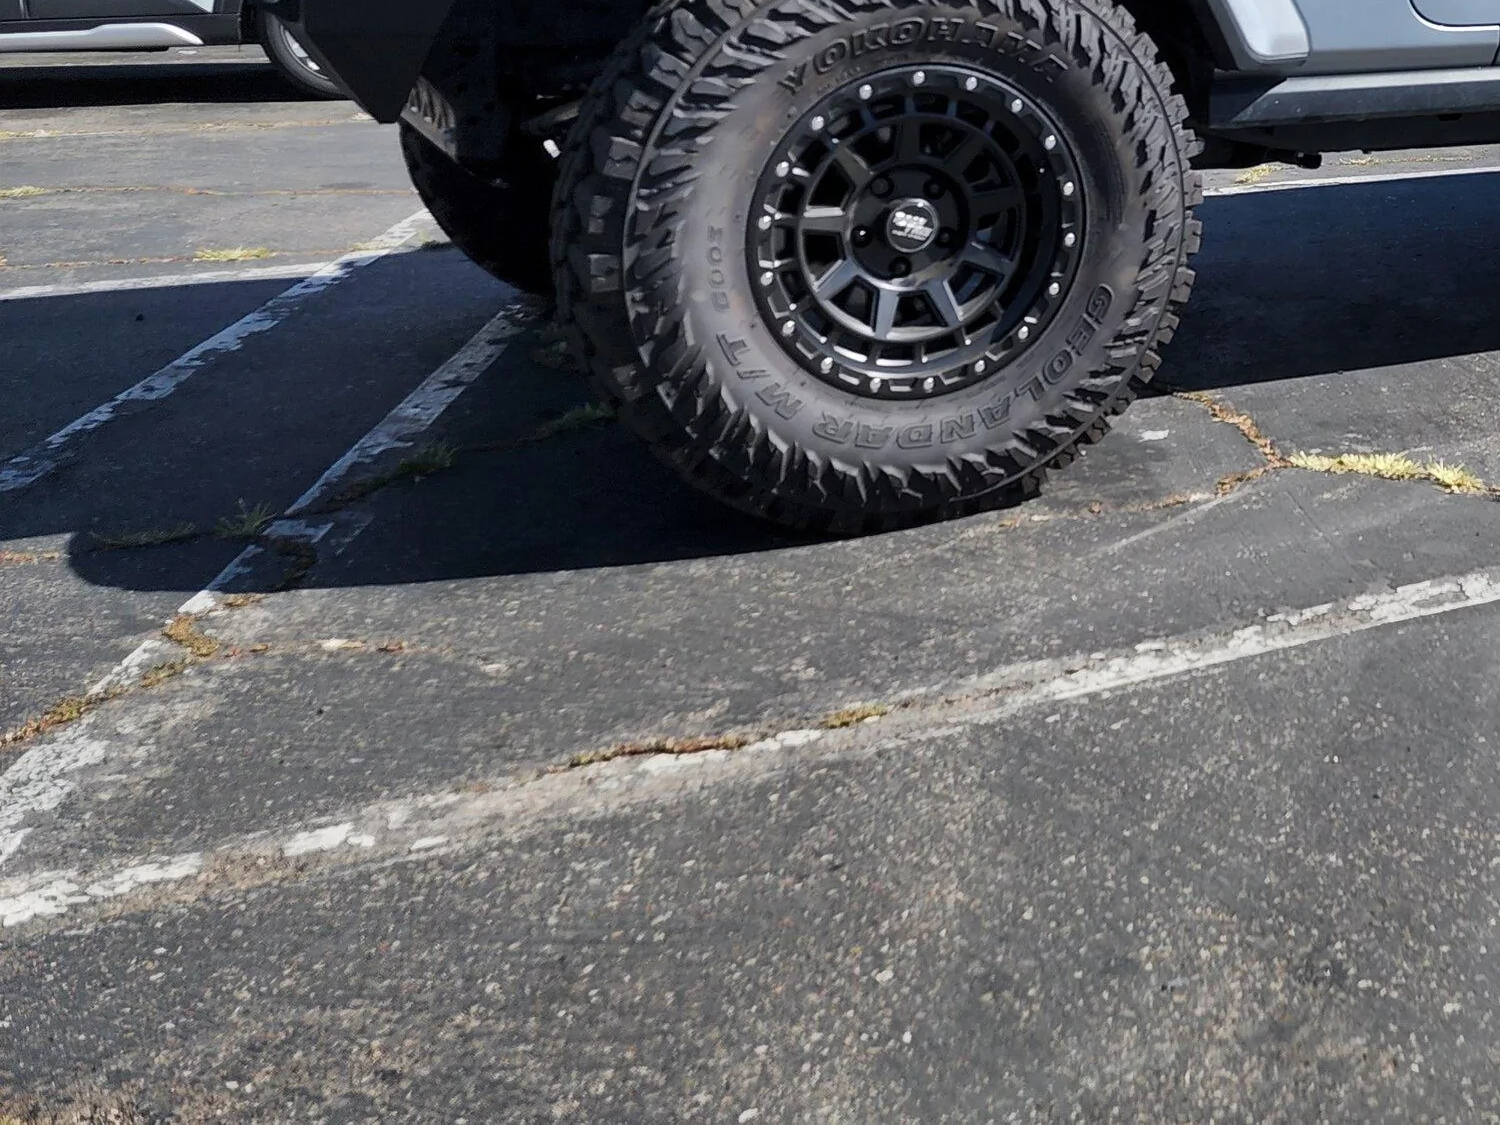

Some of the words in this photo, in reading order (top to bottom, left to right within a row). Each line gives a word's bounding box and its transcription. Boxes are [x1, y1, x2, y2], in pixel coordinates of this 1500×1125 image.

[777, 17, 1069, 97] YOKOHAMA
[716, 332, 805, 421] M/T
[812, 283, 1115, 449] GEOLANDAR
